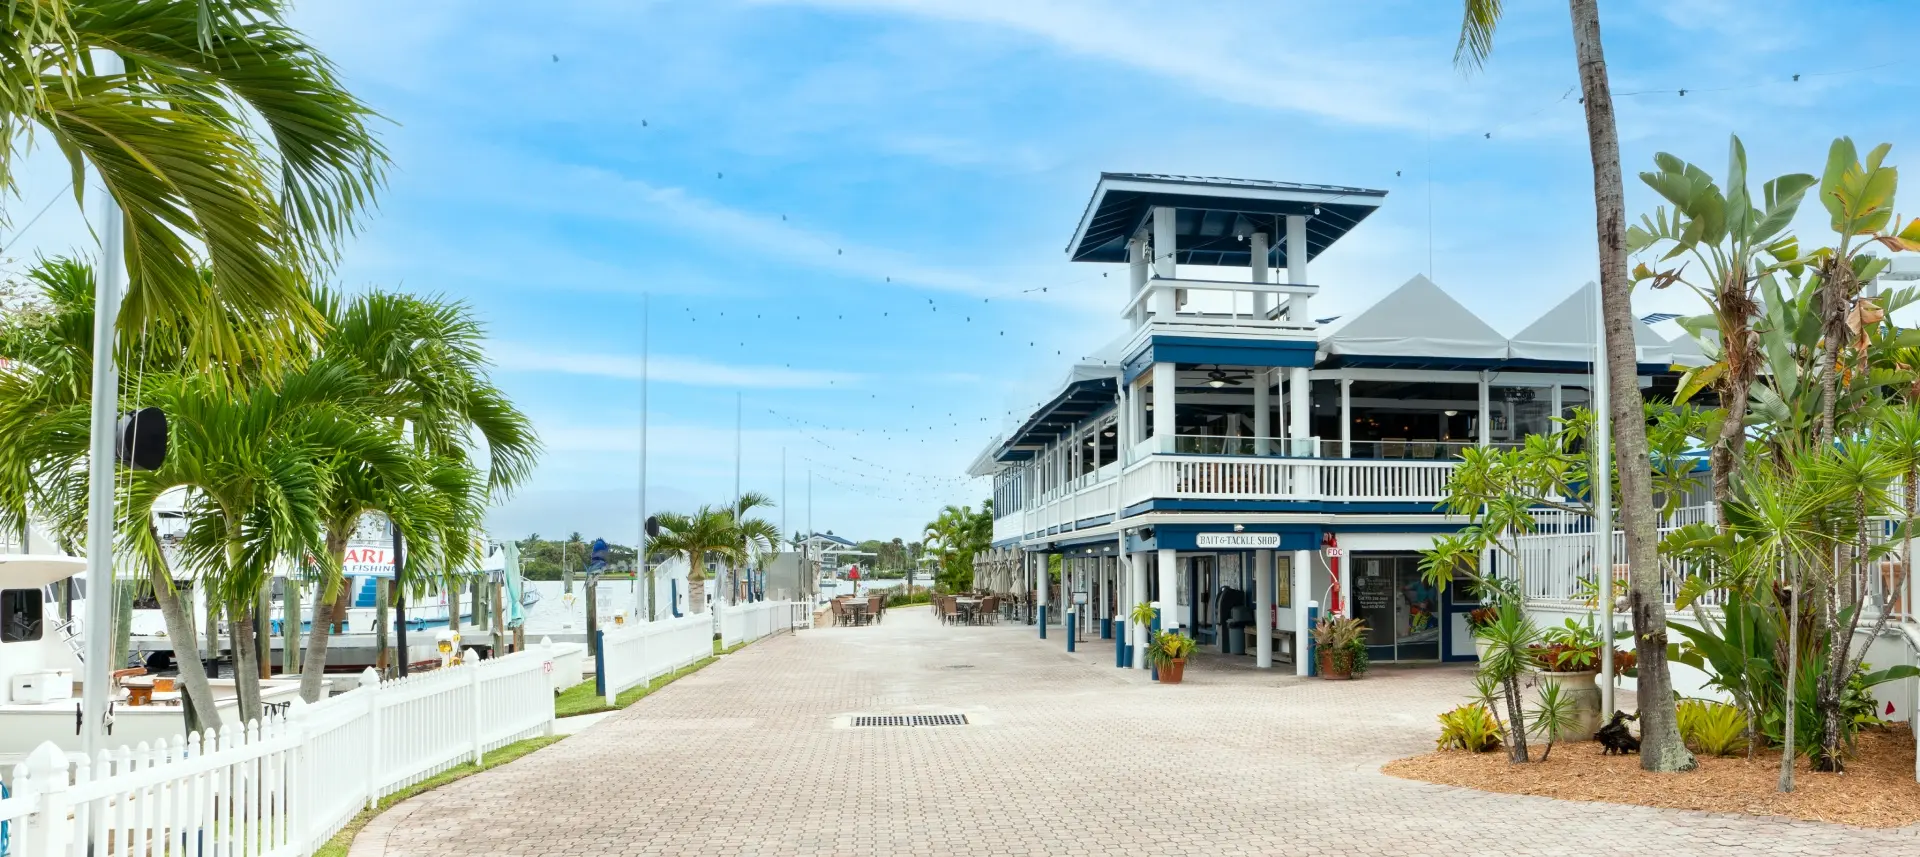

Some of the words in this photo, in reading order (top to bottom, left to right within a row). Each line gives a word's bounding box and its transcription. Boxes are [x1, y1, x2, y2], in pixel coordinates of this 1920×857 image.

[1200, 535, 1219, 545] BAIT
[1226, 535, 1255, 545] TACKLE
[1257, 535, 1278, 545] SHOP
[1327, 548, 1343, 556] FDC
